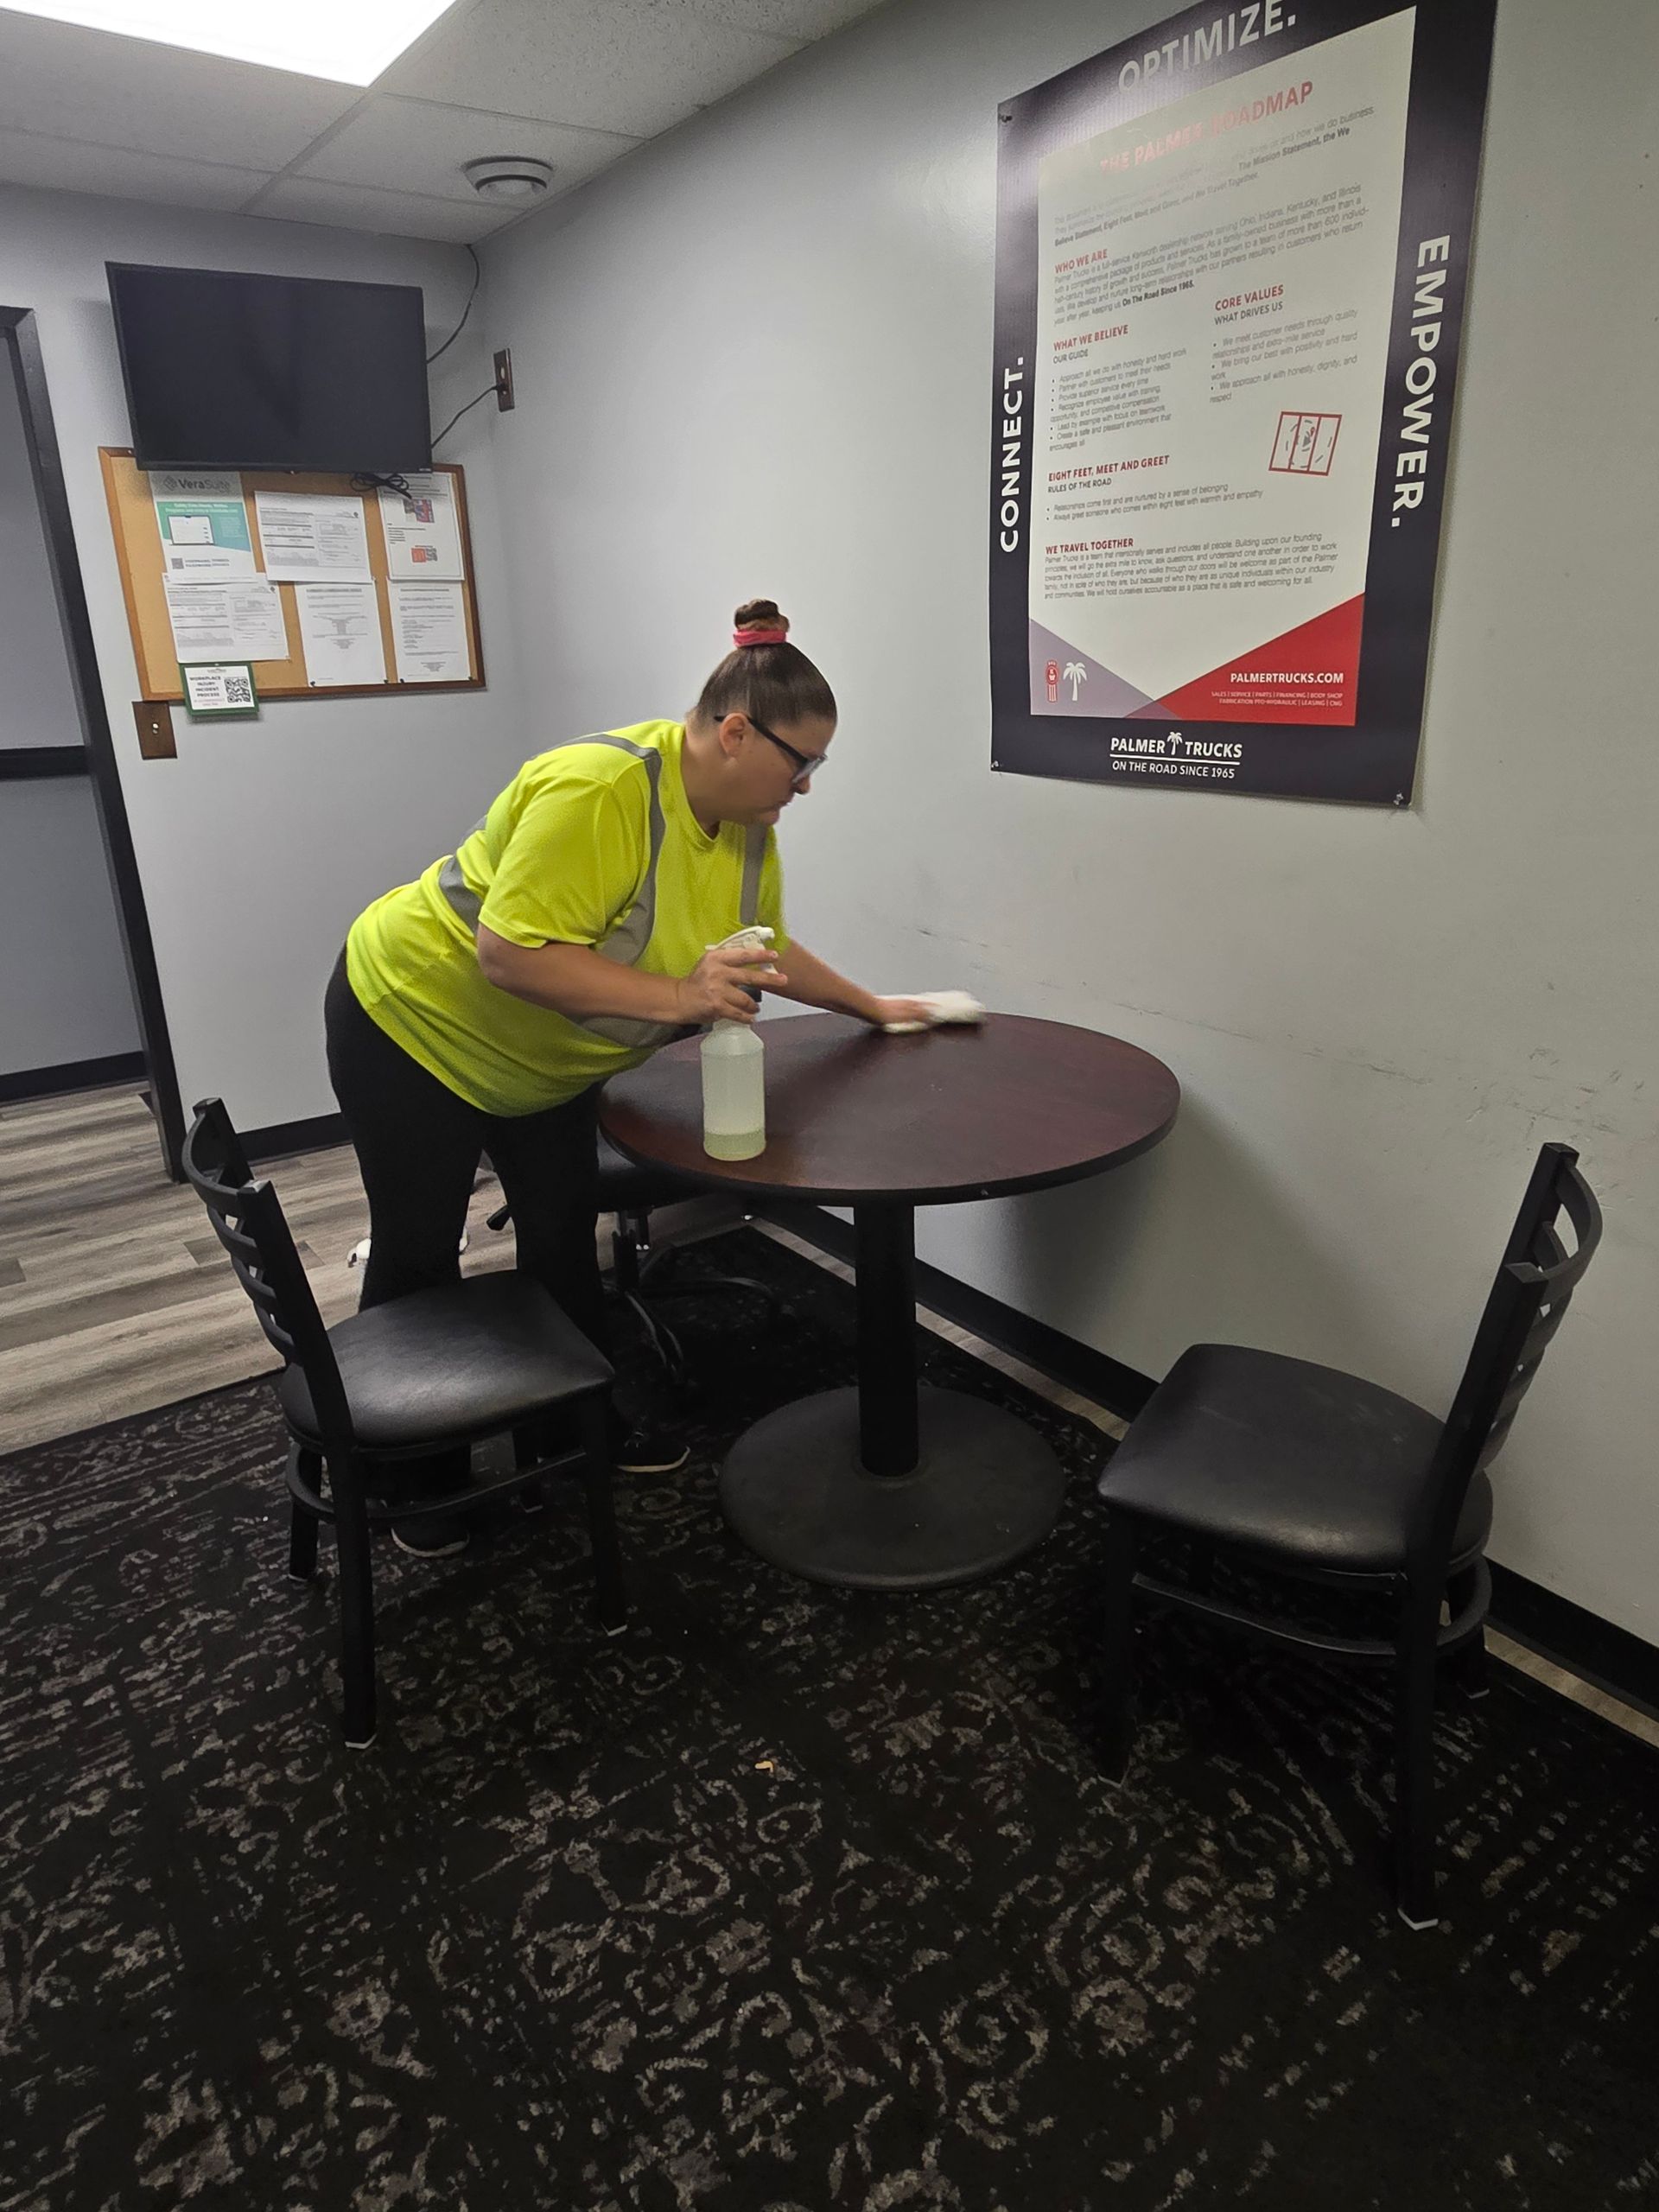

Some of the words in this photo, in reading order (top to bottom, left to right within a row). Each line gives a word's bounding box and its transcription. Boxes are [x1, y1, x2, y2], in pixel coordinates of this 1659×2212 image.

[1119, 0, 1295, 91] OPTIMIZE.
[1211, 80, 1313, 138] ROADMAP
[1055, 260, 1074, 274] WHO
[1077, 254, 1089, 267] WE
[1091, 249, 1108, 263] ARE
[1215, 296, 1242, 311] CORE
[1244, 284, 1284, 303] VALUES
[1214, 312, 1238, 325] WHAT
[1241, 304, 1269, 320] DRIVES
[1272, 302, 1283, 312] US
[1053, 338, 1077, 352] WHAT
[1079, 334, 1092, 346] WE
[1095, 325, 1128, 341] BELIEVE
[1053, 353, 1067, 364] OUR
[1068, 349, 1089, 360] GUIDE
[1391, 235, 1450, 528] EMPOWER.
[999, 356, 1025, 553] CONNECT.
[1048, 469, 1071, 482] EIGHT
[1073, 467, 1094, 479] FEET,
[1096, 462, 1118, 474] MEET
[1121, 460, 1139, 472] AND
[1141, 454, 1170, 468] GREET
[1047, 484, 1066, 493] RULES
[1068, 482, 1077, 491] OF
[1078, 480, 1090, 489] THE
[1092, 478, 1112, 487] ROAD
[1046, 545, 1058, 555] WE
[1059, 542, 1089, 553] TRAVEL
[1090, 537, 1134, 550] TOGETHER
[1230, 672, 1344, 683] PALMERTRUCKS.COM
[1110, 737, 1166, 754] PALMER
[1185, 741, 1243, 758] TRUCKS
[1112, 760, 1126, 771] ON
[1128, 761, 1147, 772] THE
[1148, 762, 1178, 774] ROAD
[1179, 765, 1209, 777] SINCE
[1211, 767, 1235, 779] 1965
